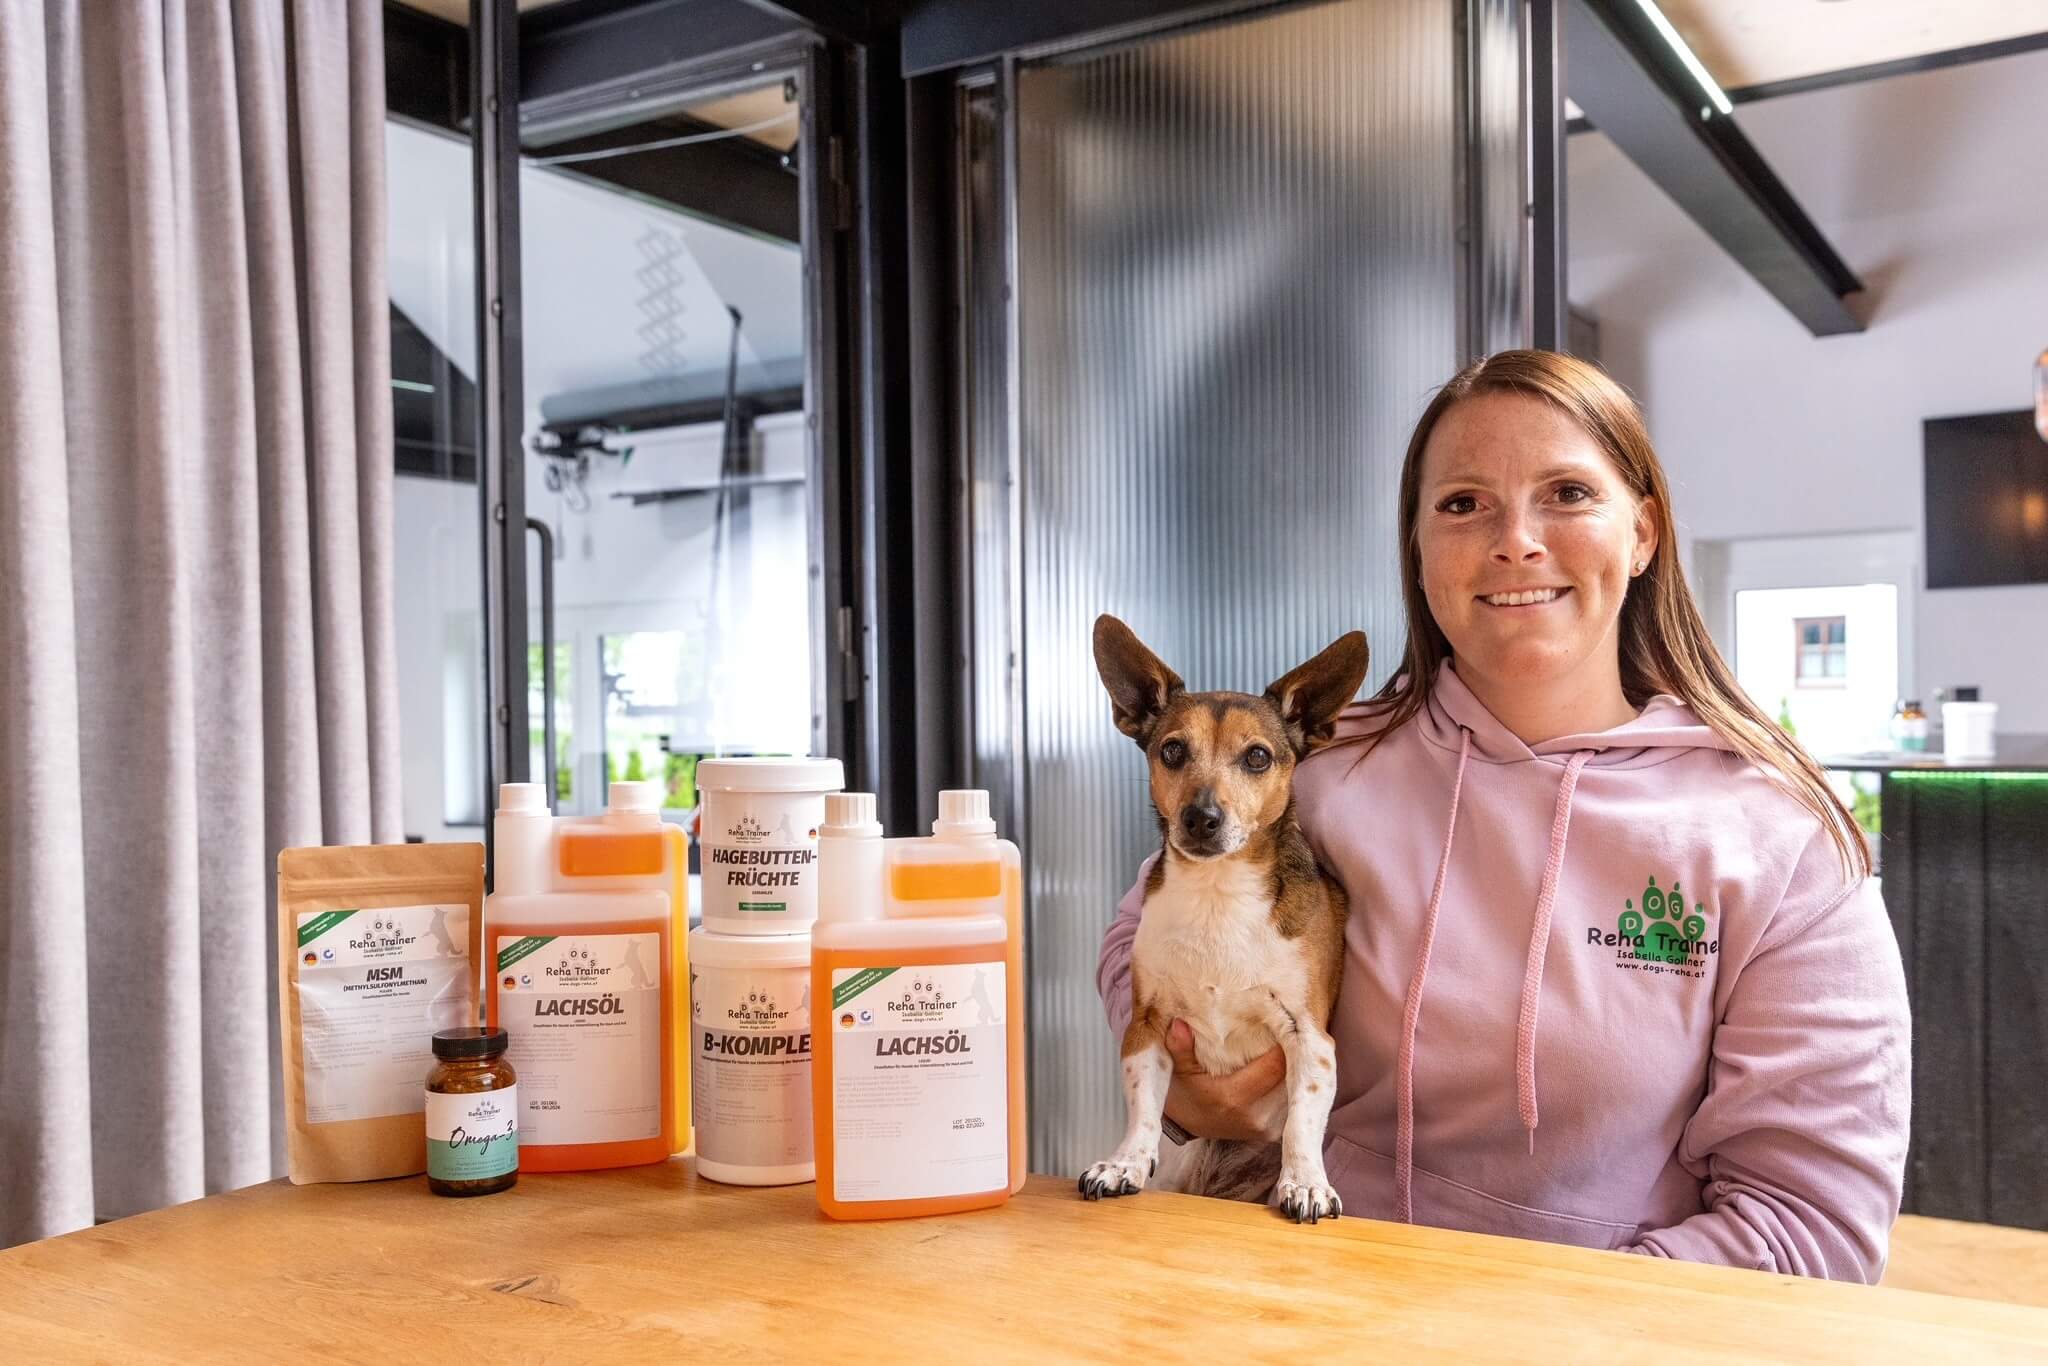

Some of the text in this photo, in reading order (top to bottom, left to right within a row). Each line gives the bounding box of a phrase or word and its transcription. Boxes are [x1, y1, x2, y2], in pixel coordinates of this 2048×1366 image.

[746, 829, 771, 837] Trainer
[712, 848, 817, 865] HAGEBUTTEN-
[727, 867, 800, 886] FRÜCHTE
[350, 936, 417, 949] Reha Trainer
[1587, 927, 1718, 955] Reha Traine
[1617, 949, 1706, 967] Isabella Gollner
[366, 967, 403, 982] MSM
[546, 966, 611, 976] Reha Trainer
[1616, 962, 1705, 978] www.dogs-reha.at
[343, 978, 428, 992] (METHYLSULFONYLMETHAN)
[535, 993, 624, 1016] LACHSÖL
[888, 1000, 957, 1011] Reha Trainer
[728, 1009, 789, 1019] Reha Trainer
[703, 1032, 812, 1056] B-KOMPLE
[876, 1029, 971, 1056] LACHSÖL
[449, 1119, 513, 1155] Omega-3
